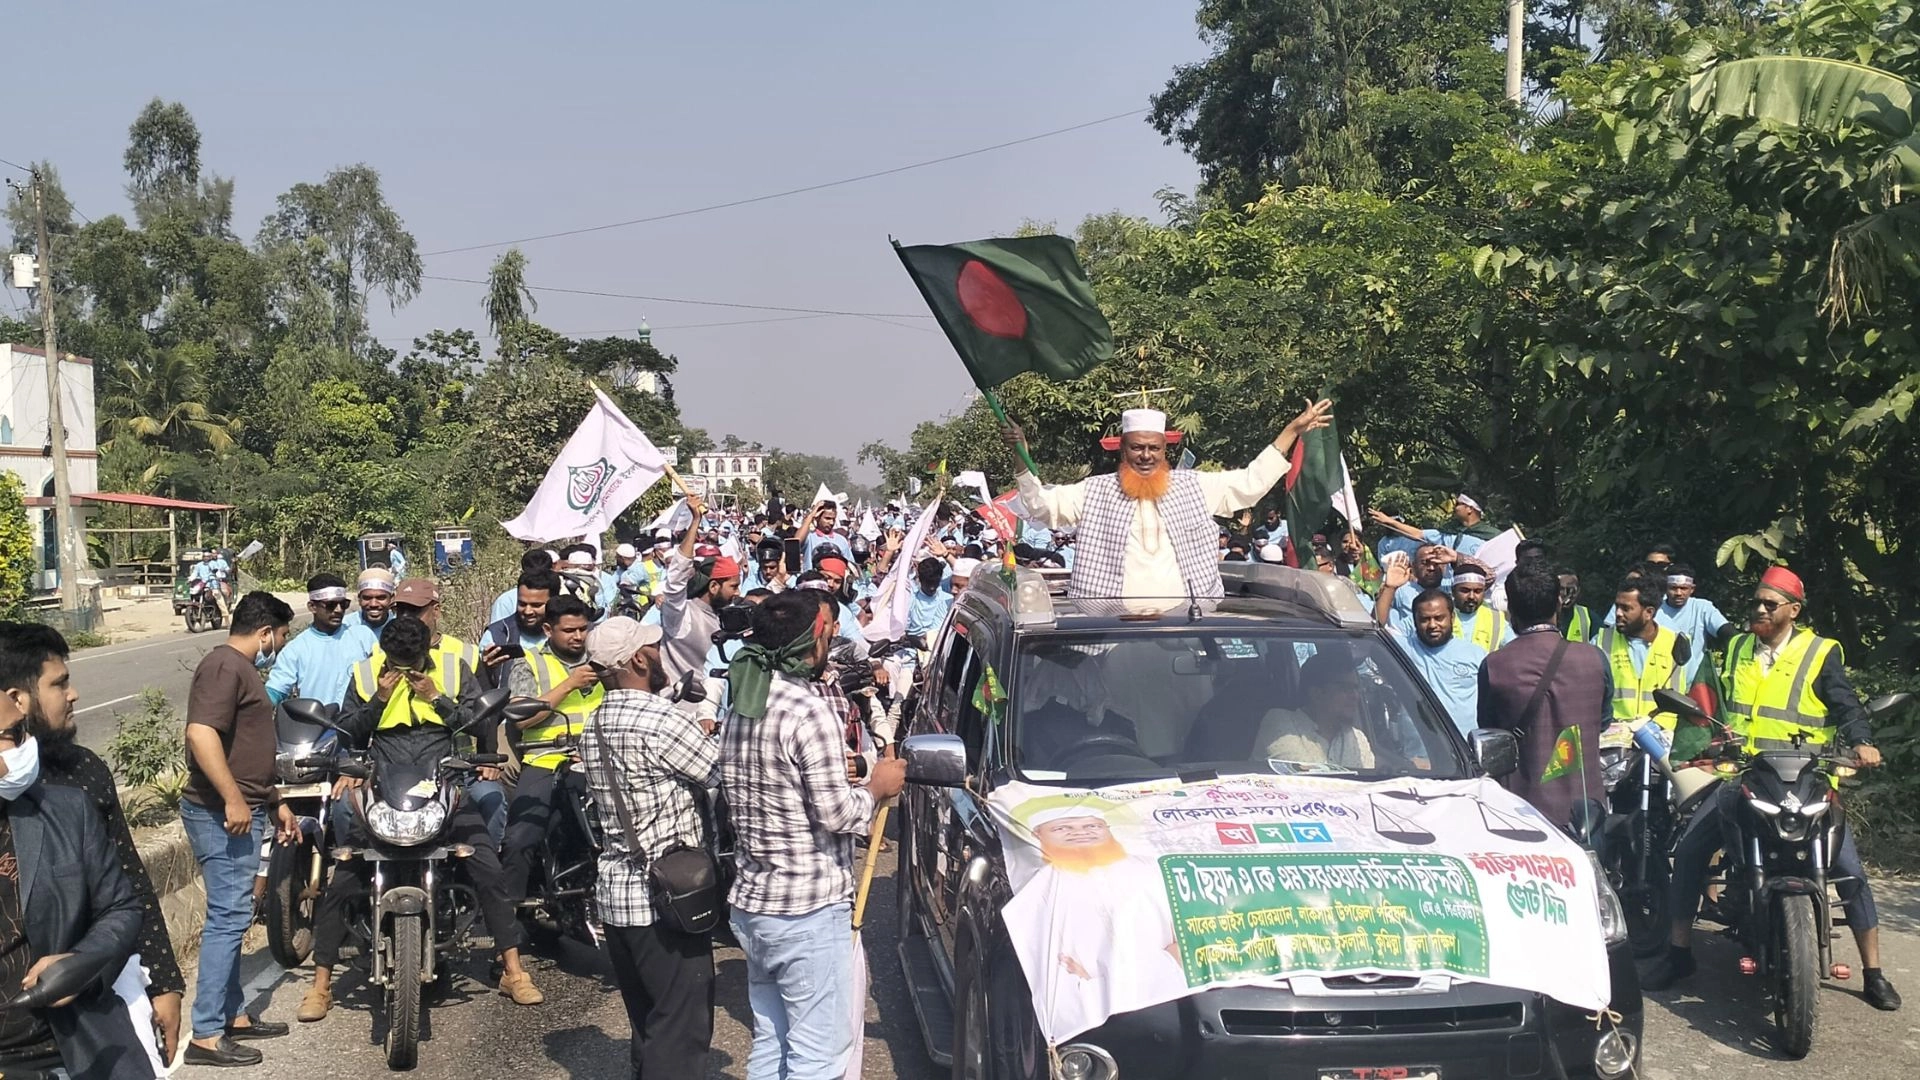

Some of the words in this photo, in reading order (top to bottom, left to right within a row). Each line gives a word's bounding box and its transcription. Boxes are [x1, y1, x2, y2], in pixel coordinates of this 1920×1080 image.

[1238, 866, 1255, 895] এ
[1252, 866, 1275, 892] কে
[1277, 865, 1306, 891] এম
[1185, 916, 1217, 936] সাবেক
